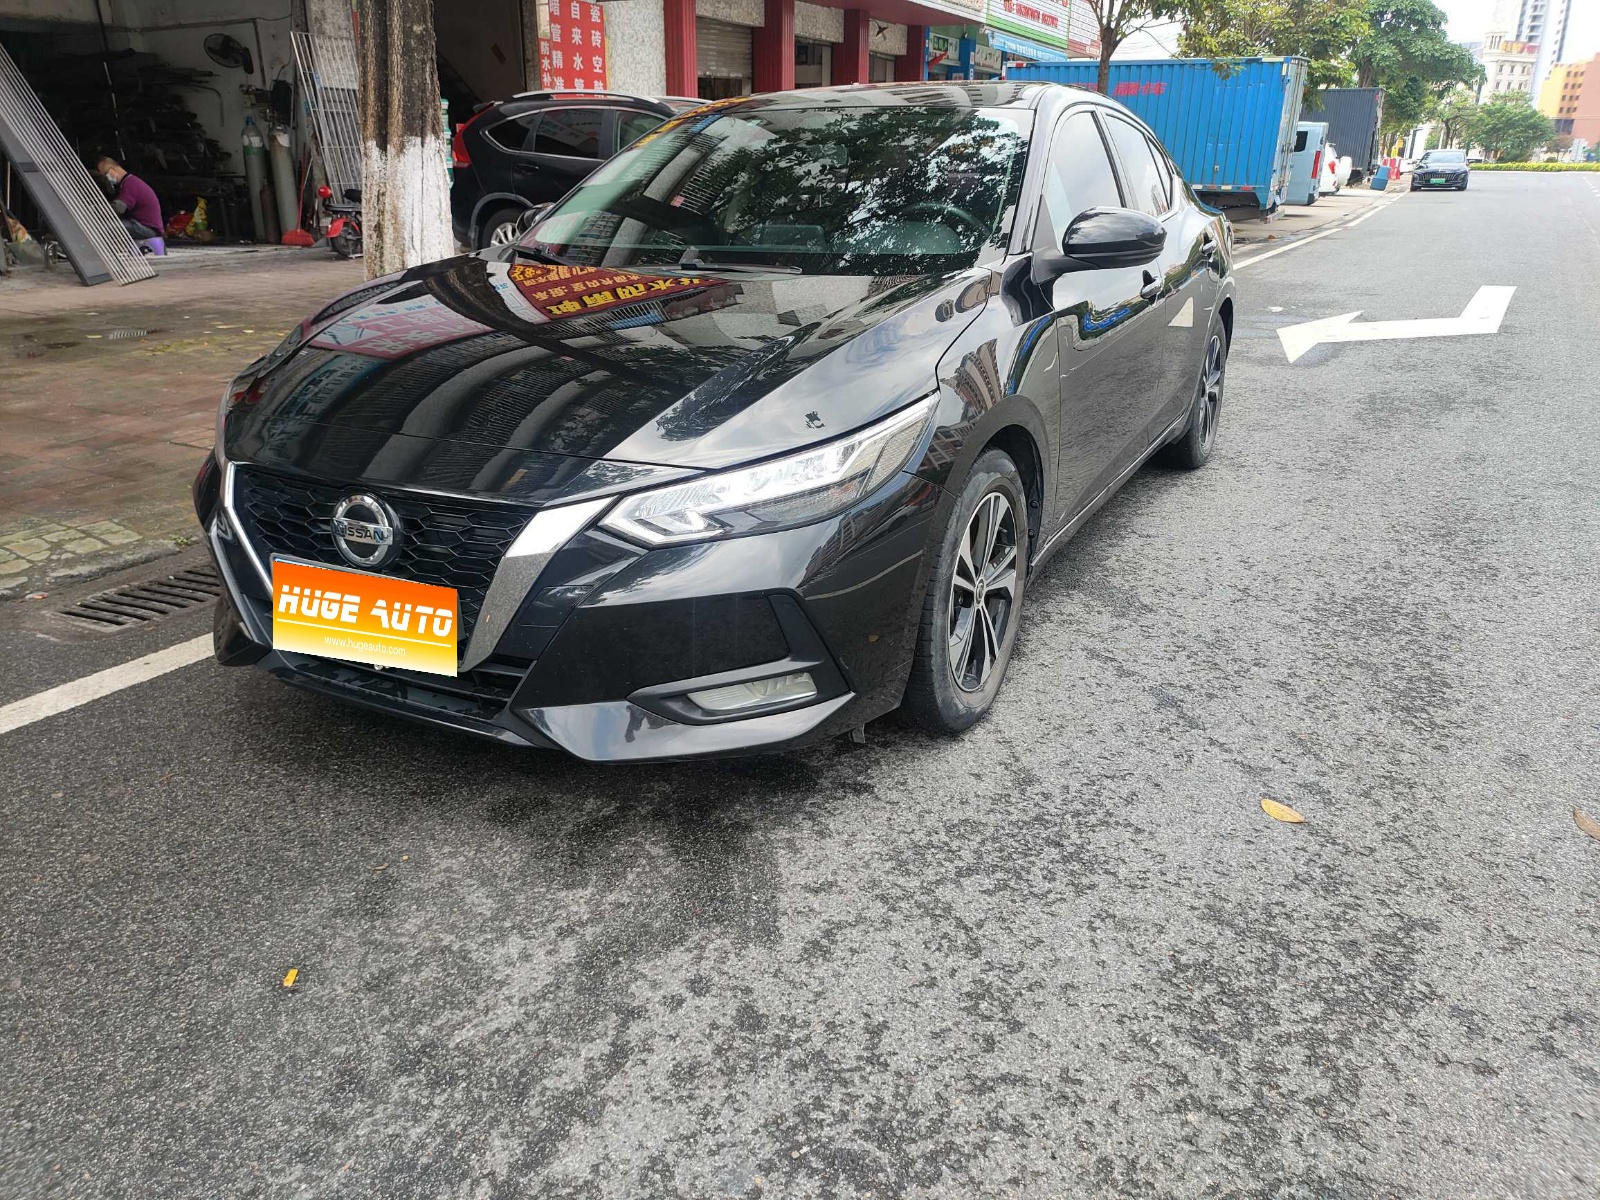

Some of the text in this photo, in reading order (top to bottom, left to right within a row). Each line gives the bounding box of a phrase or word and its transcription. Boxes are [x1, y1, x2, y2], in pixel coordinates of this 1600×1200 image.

[540, 41, 552, 90] 防水补
[335, 519, 384, 541] NISSAN
